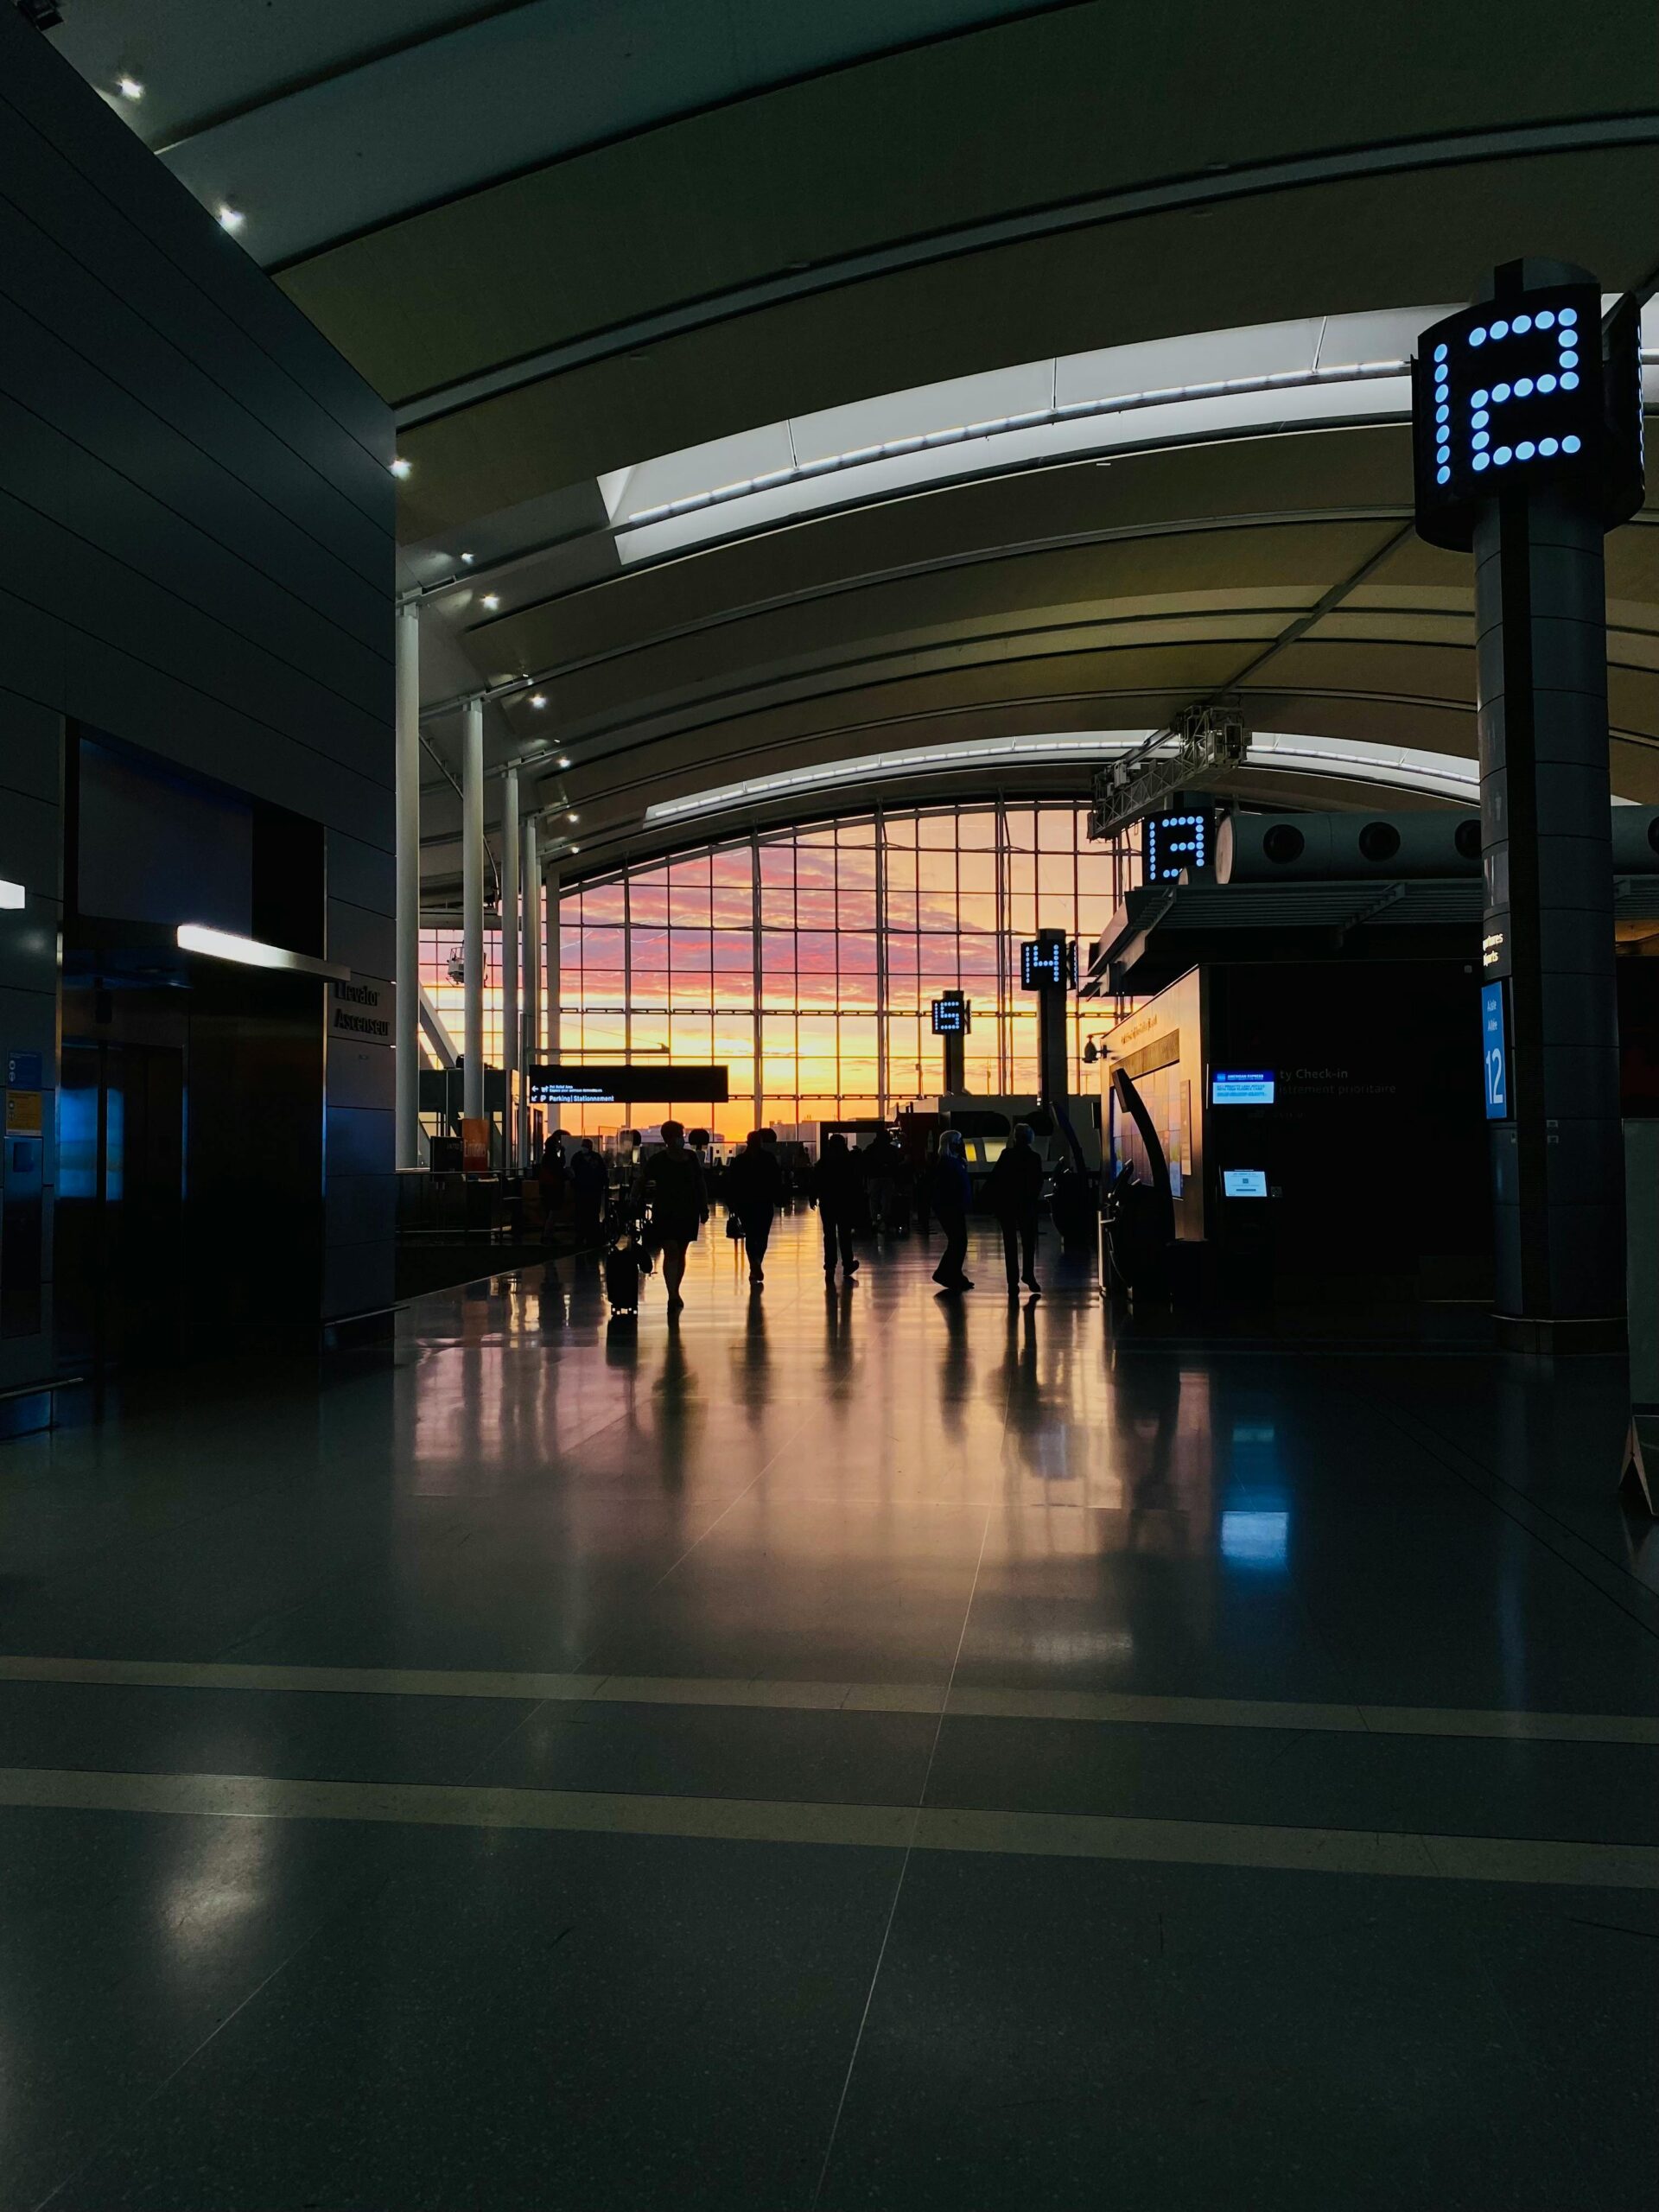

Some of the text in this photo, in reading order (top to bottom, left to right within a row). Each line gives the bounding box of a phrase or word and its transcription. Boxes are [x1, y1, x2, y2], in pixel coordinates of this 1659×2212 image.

[1433, 308, 1581, 485] 12
[1148, 816, 1205, 880] 13
[1025, 944, 1059, 983] 14
[934, 1001, 960, 1031] 15
[1295, 1068, 1348, 1079] Check-in
[1485, 1047, 1503, 1104] 12
